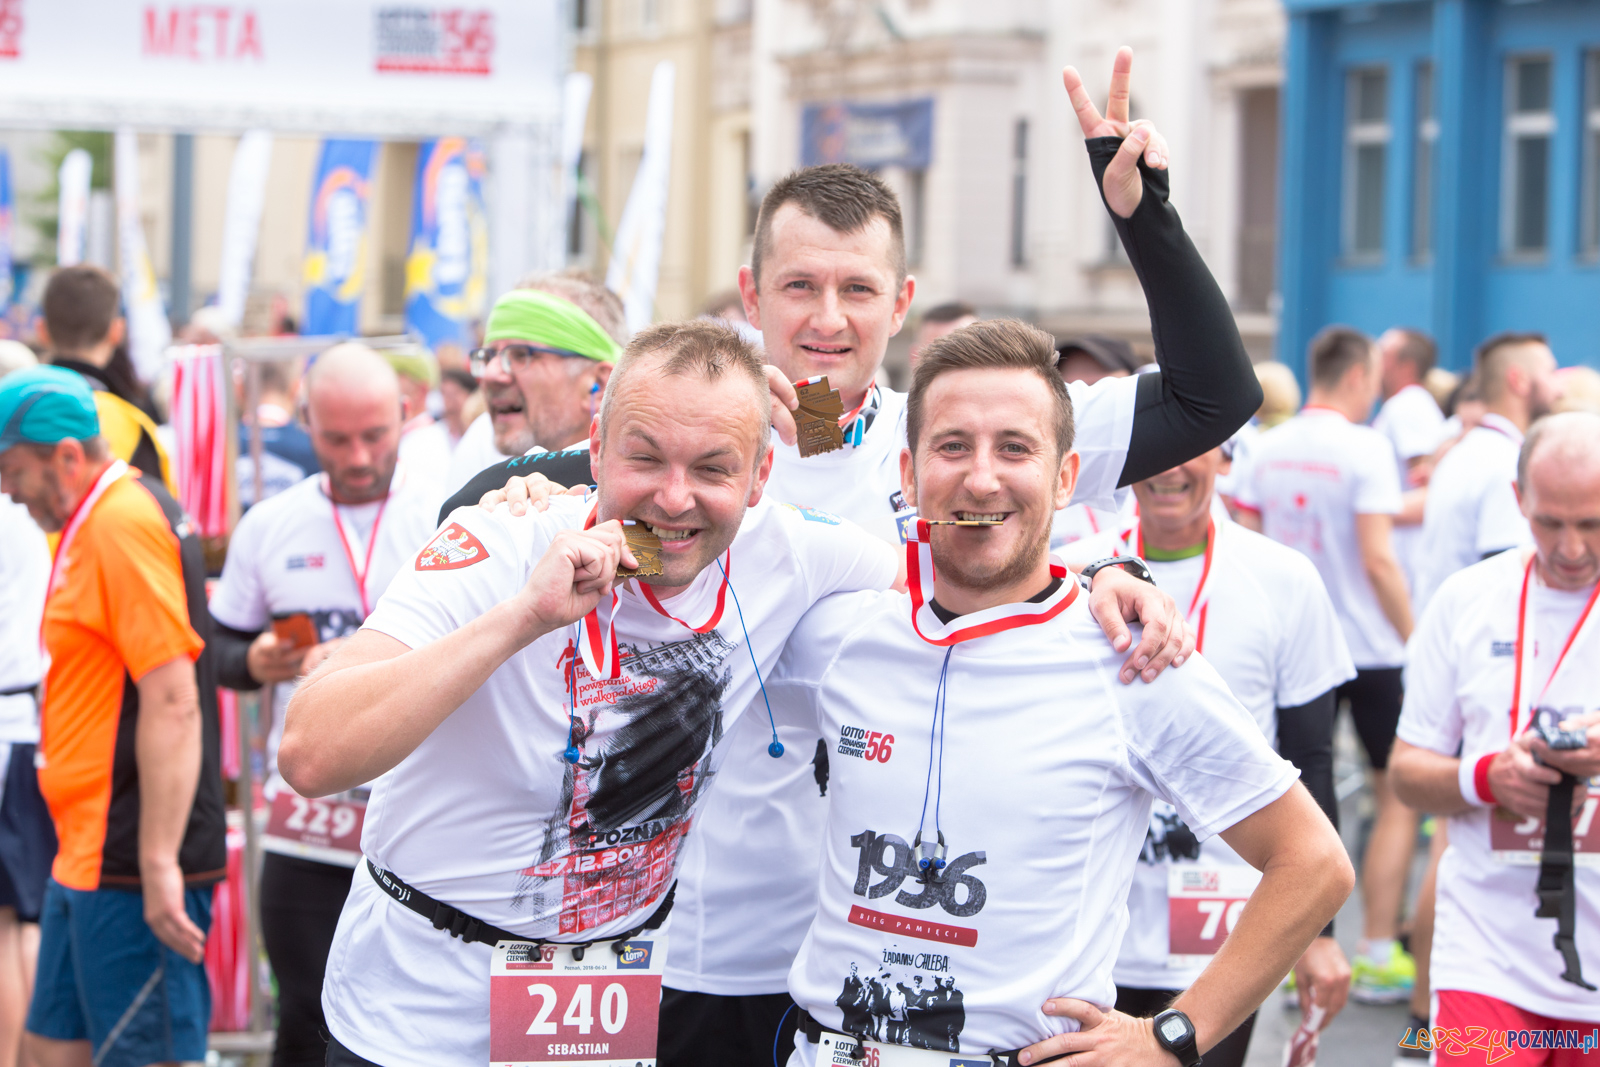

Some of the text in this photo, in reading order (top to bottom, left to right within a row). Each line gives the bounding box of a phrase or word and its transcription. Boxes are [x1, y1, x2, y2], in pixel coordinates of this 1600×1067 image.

[142, 8, 263, 58] META
[506, 449, 582, 469] KIPSTA
[578, 675, 632, 698] powstania
[579, 677, 658, 706] wielkopolskiego
[841, 725, 865, 740] LOTTO
[837, 745, 865, 759] CZERWIEC
[285, 796, 357, 838] 229
[373, 864, 412, 901] alenji
[850, 829, 988, 917] 1956
[859, 912, 958, 938] BIEG PAMIĘCI
[625, 951, 644, 961] LOTTO
[914, 952, 949, 972] CHLEBA
[525, 982, 629, 1035] 240
[547, 1043, 610, 1056] SEBASTIAN
[861, 1046, 880, 1067] 56
[832, 1056, 862, 1067] CZERWIEC
